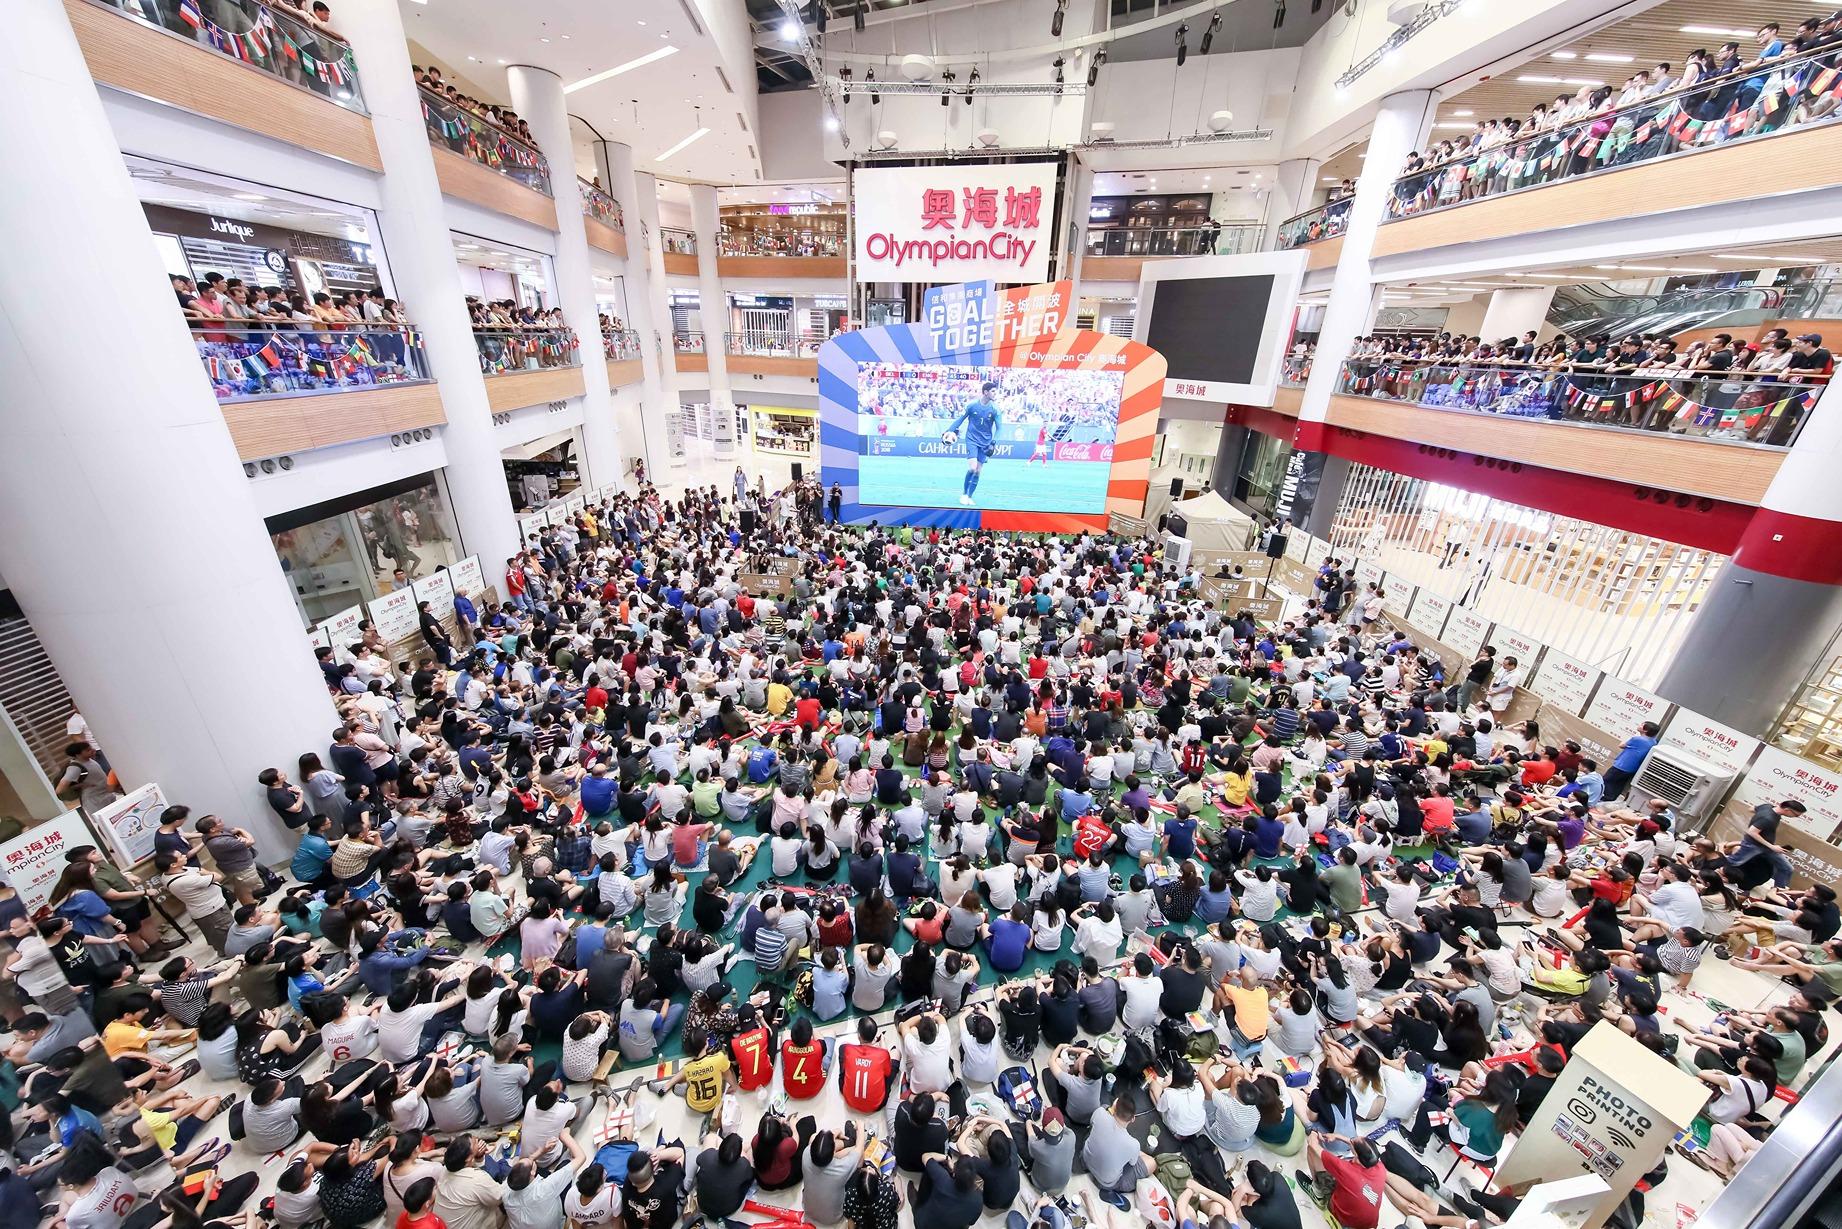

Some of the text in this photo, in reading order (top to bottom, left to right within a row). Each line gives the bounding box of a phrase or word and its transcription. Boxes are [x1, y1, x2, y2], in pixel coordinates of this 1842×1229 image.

[210, 217, 254, 242] Jurlique
[929, 311, 1059, 352] TOGETHER
[1029, 351, 1075, 363] Olympian
[1276, 475, 1300, 516] MUJI
[1685, 727, 1734, 752] OlympianCity
[1190, 753, 1201, 767] 11
[1772, 768, 1833, 798] OlympianCity
[1080, 830, 1102, 850] 22
[7, 841, 65, 875] mpianCity
[327, 1032, 355, 1045] MAGUIRE
[333, 1046, 351, 1060] 6
[746, 1043, 760, 1075] 7
[855, 1058, 872, 1067] VARDY
[792, 1057, 808, 1084] 4
[691, 1077, 716, 1100] 16
[854, 1070, 869, 1099] 11
[1577, 1086, 1645, 1137] PRINTING
[1583, 1076, 1652, 1129] PHOTO
